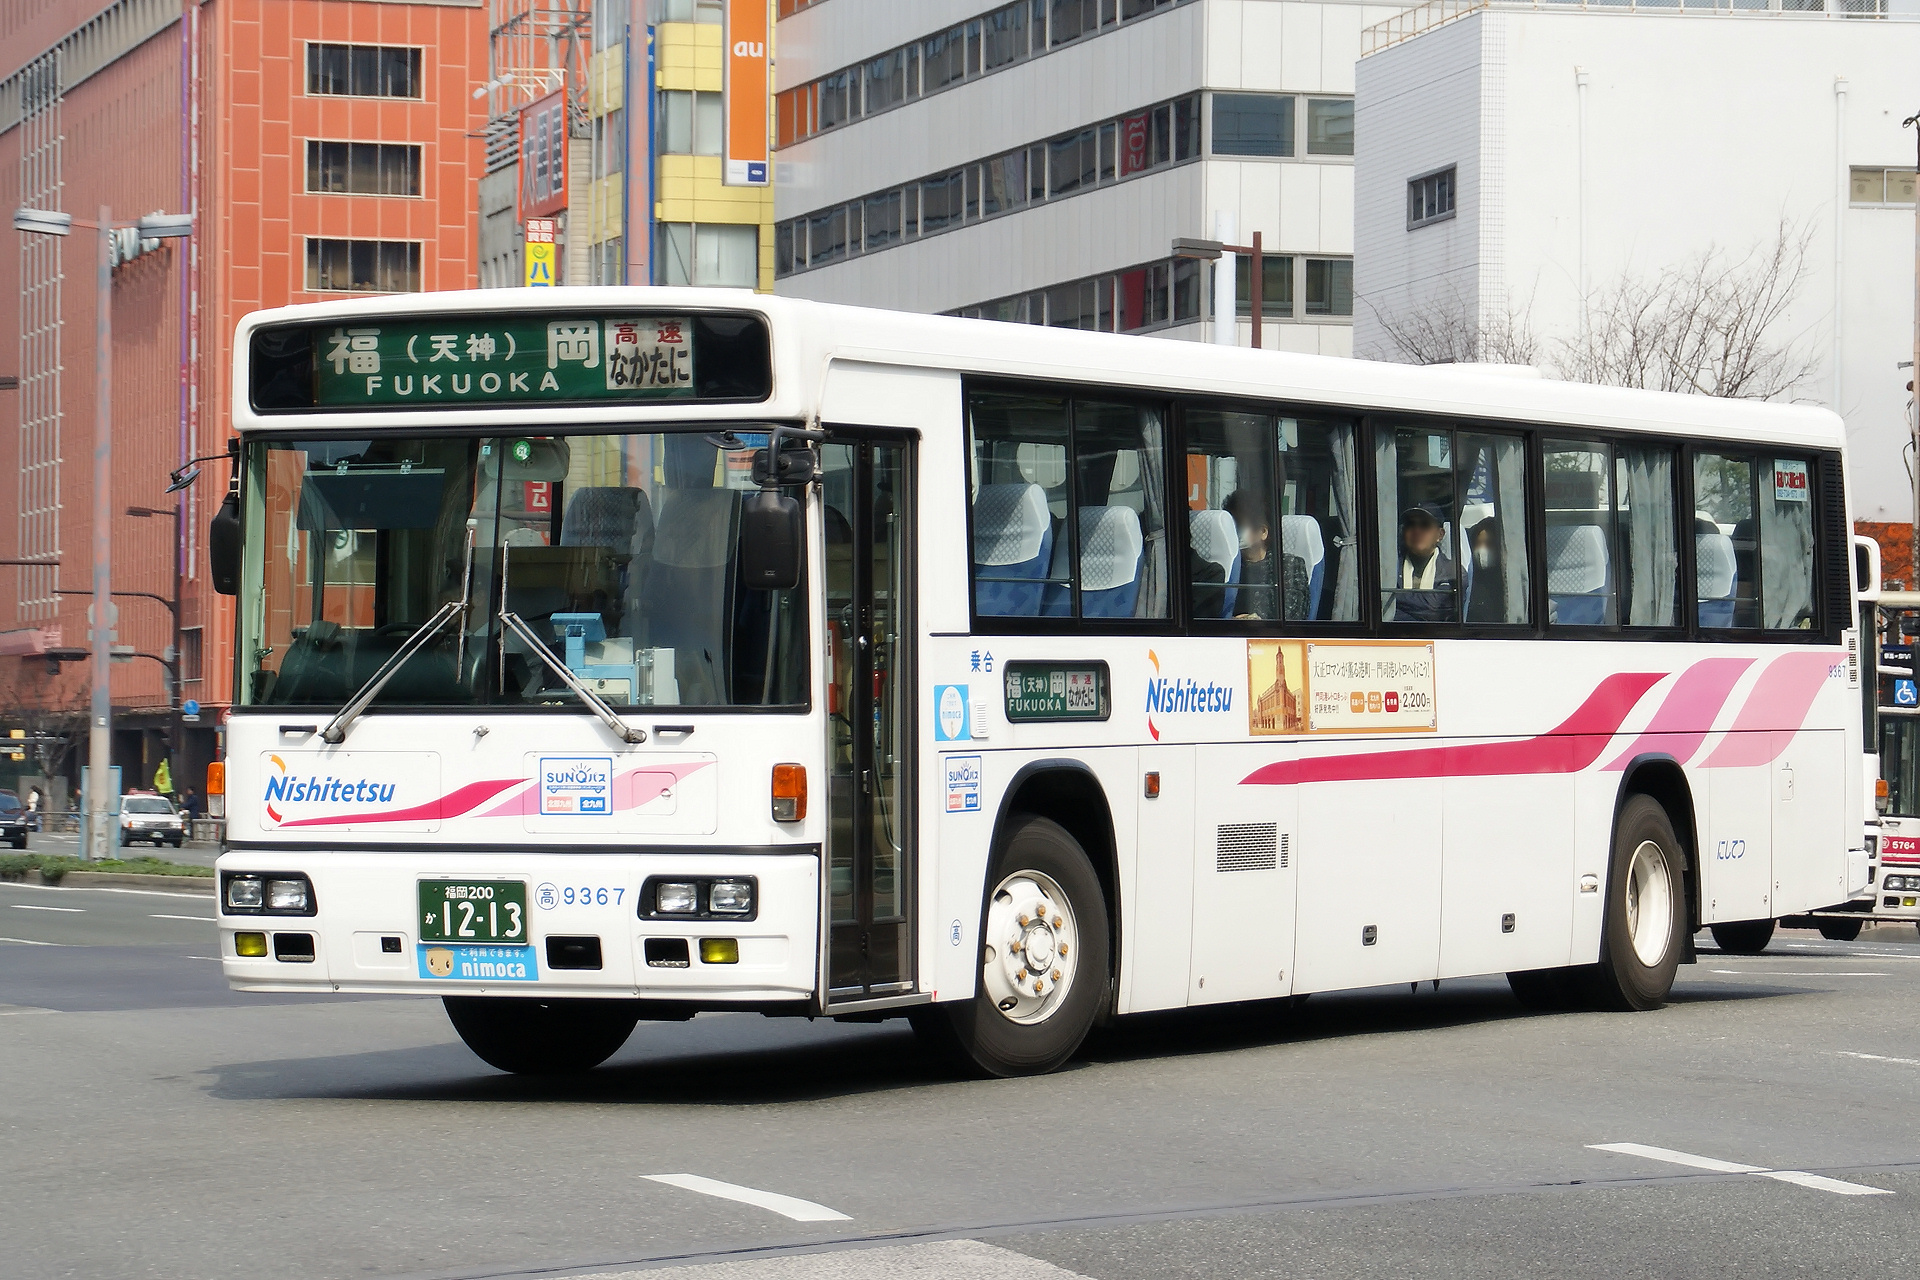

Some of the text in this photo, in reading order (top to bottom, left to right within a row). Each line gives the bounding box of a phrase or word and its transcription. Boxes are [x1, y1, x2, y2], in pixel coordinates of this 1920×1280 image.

[733, 41, 764, 58] au
[614, 321, 683, 345] 高速
[609, 346, 690, 386] なかたに
[366, 371, 560, 396] FUKUOKA
[970, 650, 994, 673] 乗合
[1829, 665, 1846, 678] 9367
[1071, 674, 1092, 685] 高速
[1008, 698, 1062, 712] FUKUOKA
[1068, 686, 1096, 707] なかたに
[1145, 677, 1233, 713] Nishitetsu
[264, 775, 396, 802] Nishitetsu
[1892, 841, 1916, 850] 5764
[563, 886, 627, 906] 9367
[424, 901, 523, 938] か 12-13
[461, 958, 527, 978] nimoca
